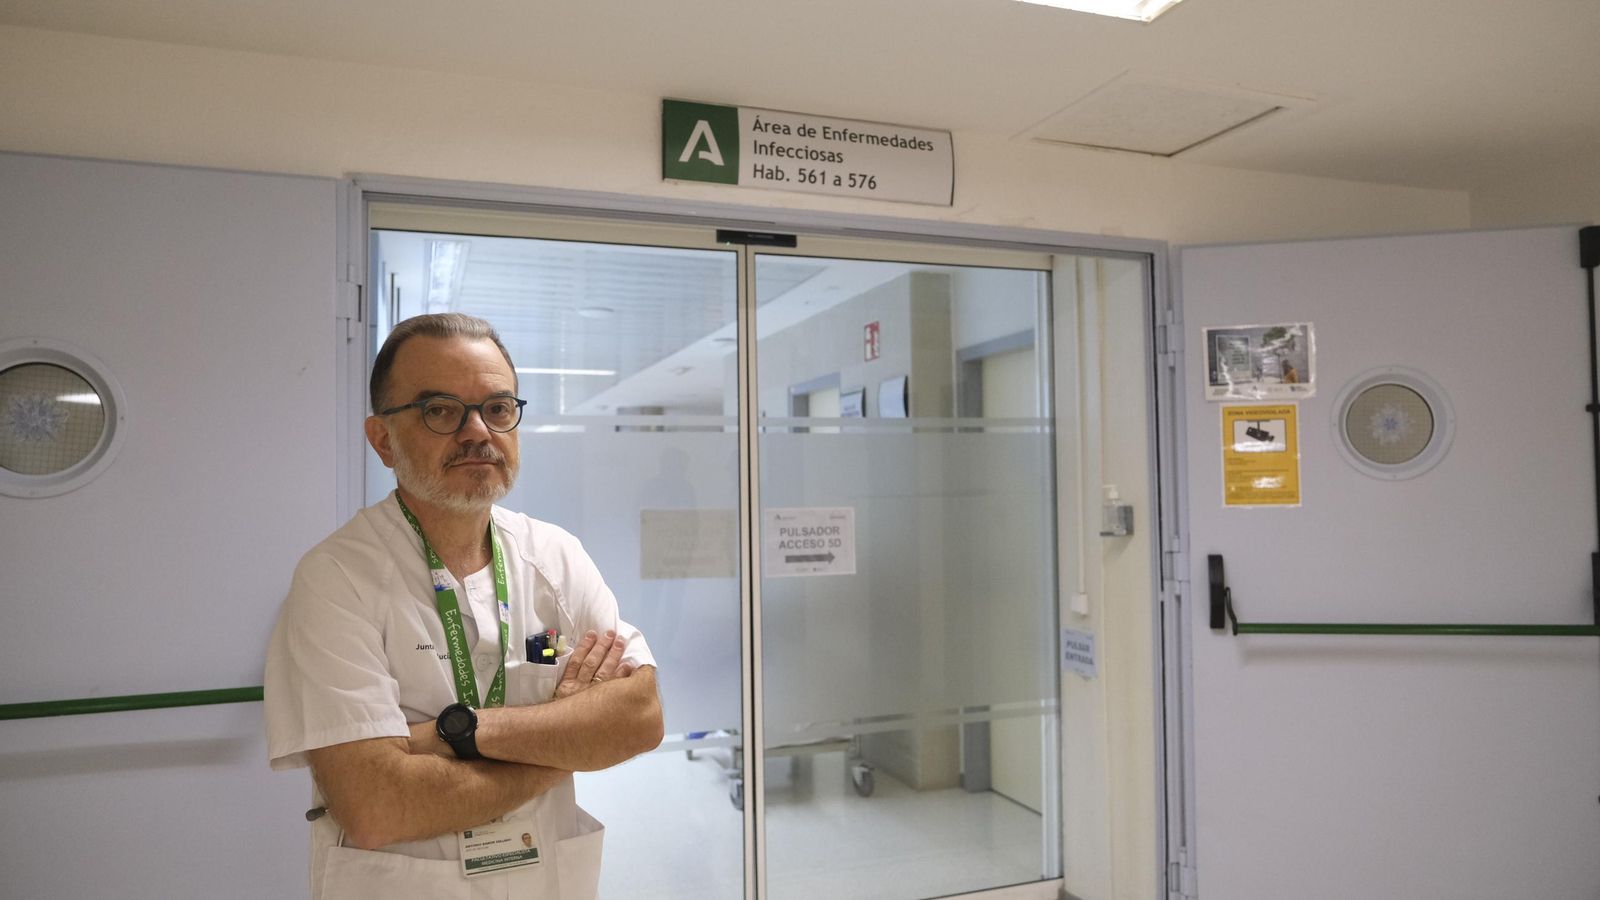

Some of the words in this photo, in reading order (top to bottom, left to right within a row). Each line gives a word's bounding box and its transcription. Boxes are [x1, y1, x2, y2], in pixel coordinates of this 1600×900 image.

[752, 115, 791, 135] Área
[796, 123, 817, 138] de
[822, 126, 934, 152] Enfermedades
[753, 140, 844, 164] Infecciosas
[753, 164, 791, 182] Hab.
[798, 168, 826, 185] 561
[833, 174, 842, 187] a
[848, 173, 877, 190] 576
[778, 539, 825, 550] ACCESO
[828, 538, 842, 549] 5D
[779, 525, 840, 538] PULSADOR
[444, 608, 471, 687] Enfermedades
